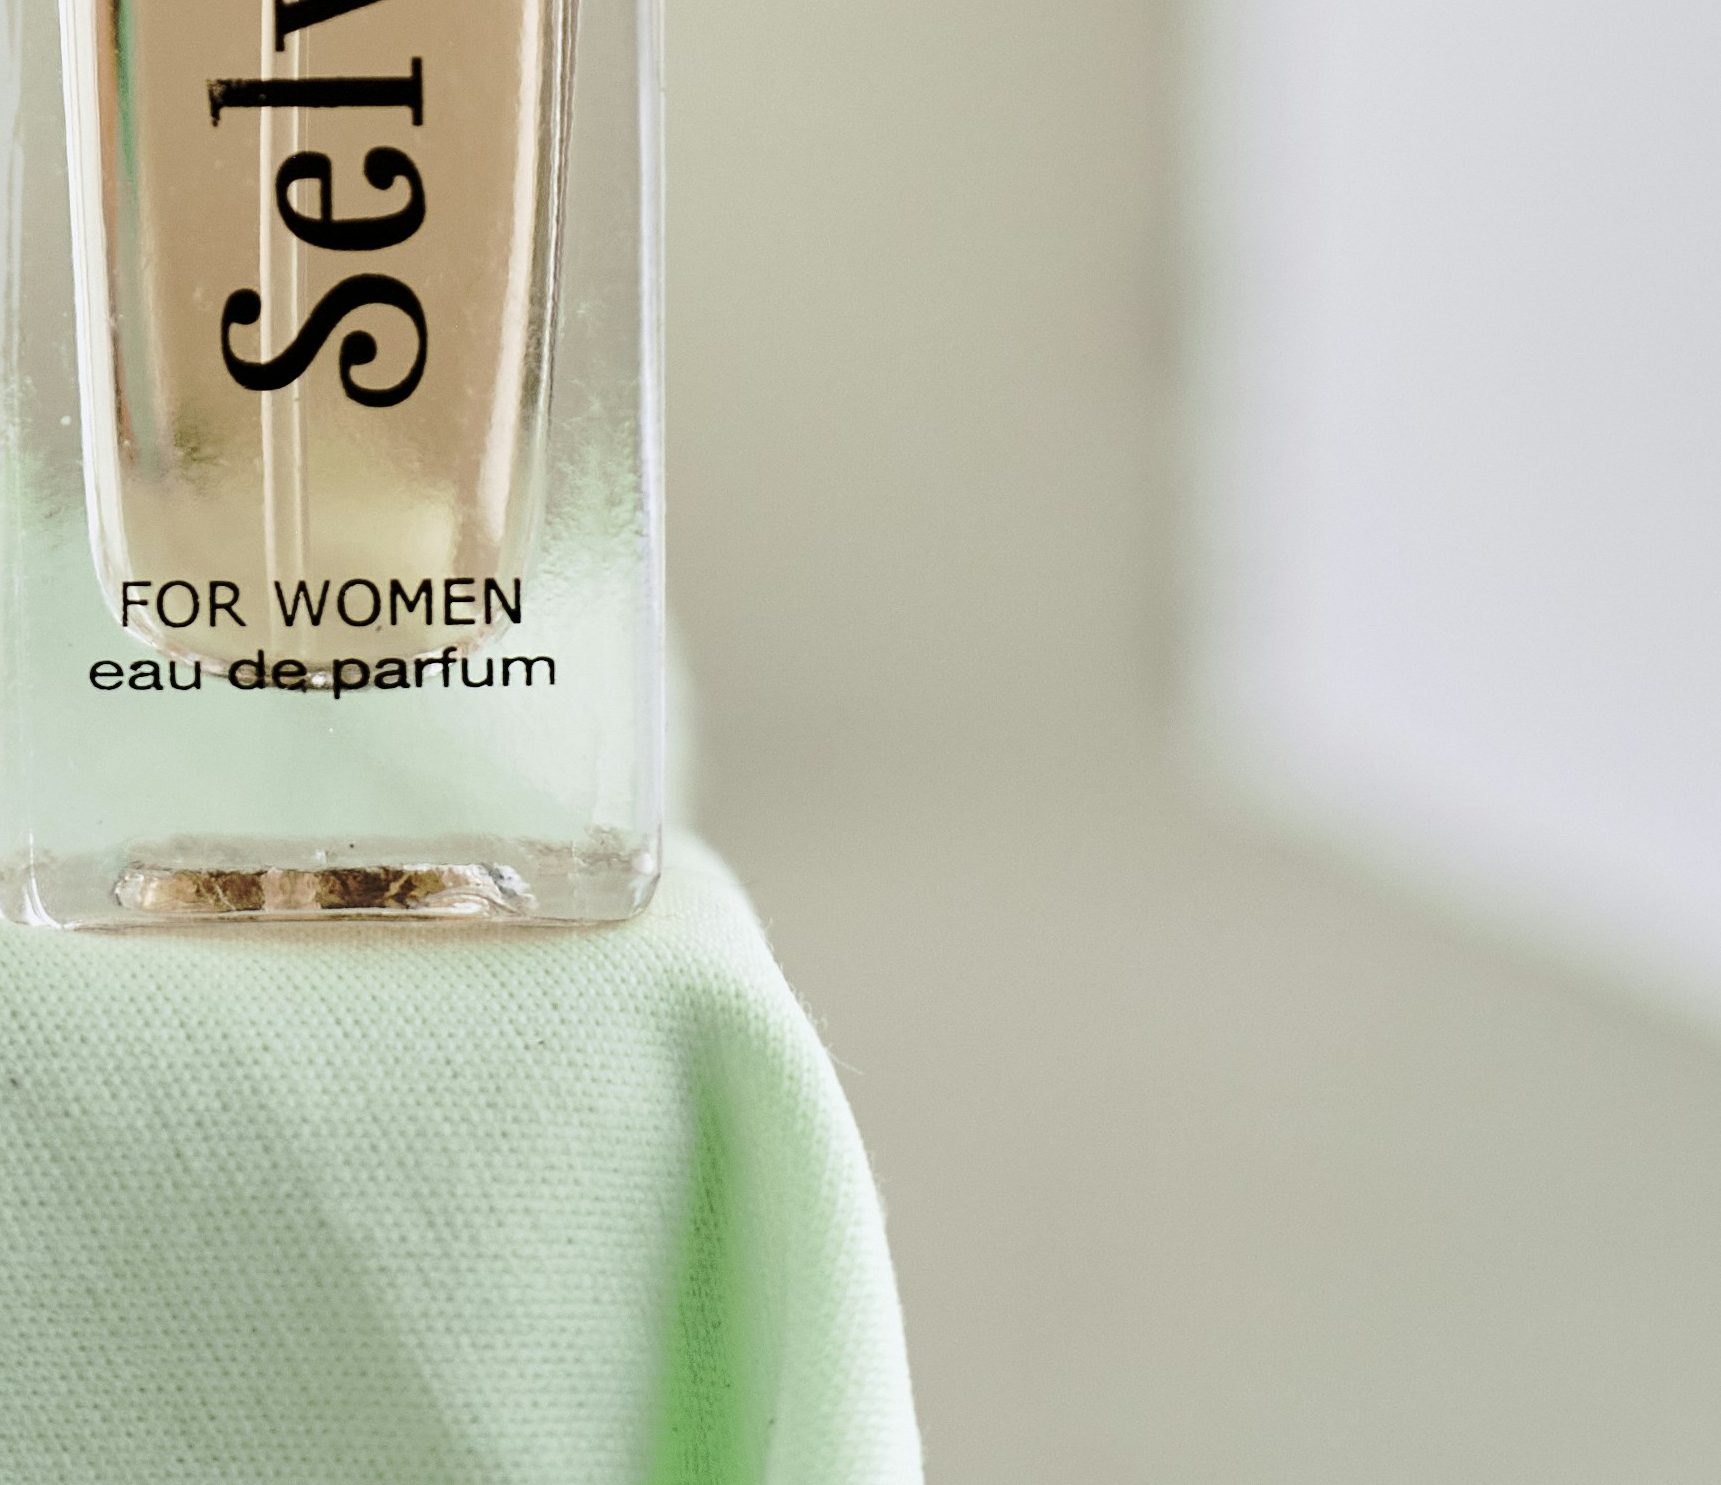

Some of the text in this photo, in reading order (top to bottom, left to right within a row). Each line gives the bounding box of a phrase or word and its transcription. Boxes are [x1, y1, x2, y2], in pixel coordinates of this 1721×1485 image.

[121, 577, 523, 628] FOR WOMEN
[88, 646, 557, 700] eau de parfum
